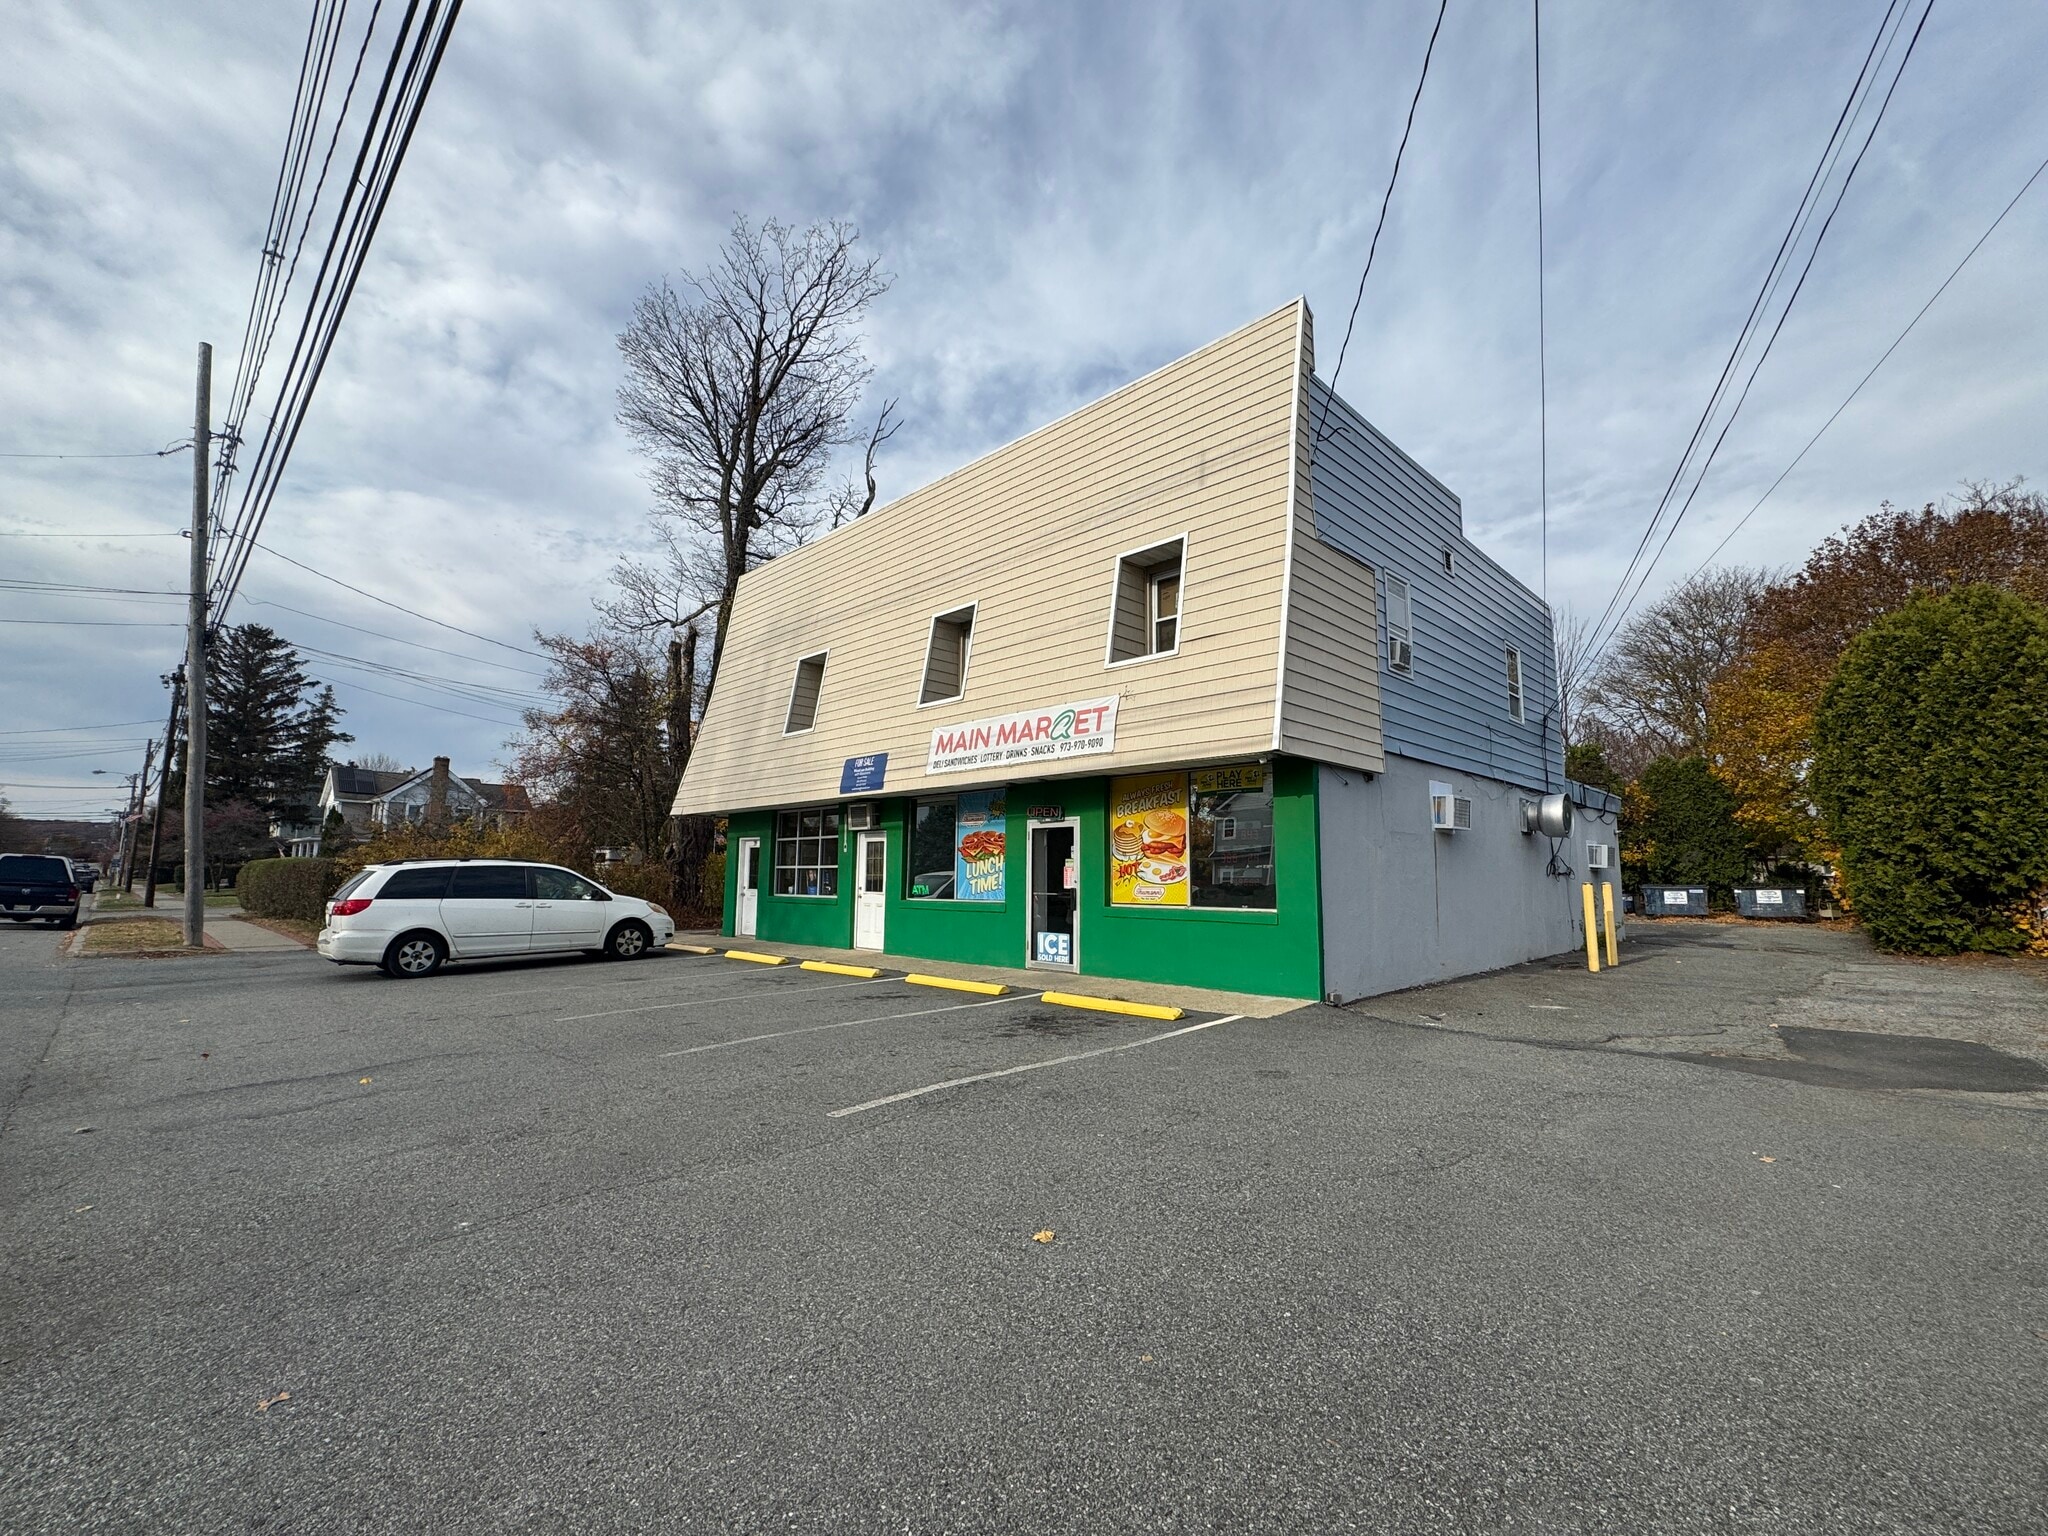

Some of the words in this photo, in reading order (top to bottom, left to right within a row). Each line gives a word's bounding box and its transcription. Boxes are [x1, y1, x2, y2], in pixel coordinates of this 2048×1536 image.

[935, 726, 991, 755] MAIN
[996, 706, 1109, 746] MARQET
[944, 755, 978, 767] SANDWICHES
[980, 751, 1003, 763] LOTTERY
[1006, 747, 1027, 760] DRINKS
[1031, 744, 1056, 756] SNACKS
[1060, 737, 1103, 752] 973-970-9090
[854, 758, 863, 768] FOR
[863, 756, 875, 766] SALE
[1216, 769, 1242, 779] PLAY
[1217, 778, 1242, 788] HERE
[1122, 787, 1150, 802] ALWAYS
[1152, 781, 1173, 794] FRESH
[1027, 807, 1059, 817] OPEN
[1116, 789, 1183, 818] BREAKFAST
[966, 855, 1003, 878] LUNCH
[1119, 862, 1140, 878] HOT
[912, 885, 929, 895] ATM
[970, 872, 1002, 895] TIME!
[1039, 934, 1068, 955] ICE
[1038, 954, 1053, 962] SOLD
[1054, 955, 1069, 963] HERE
